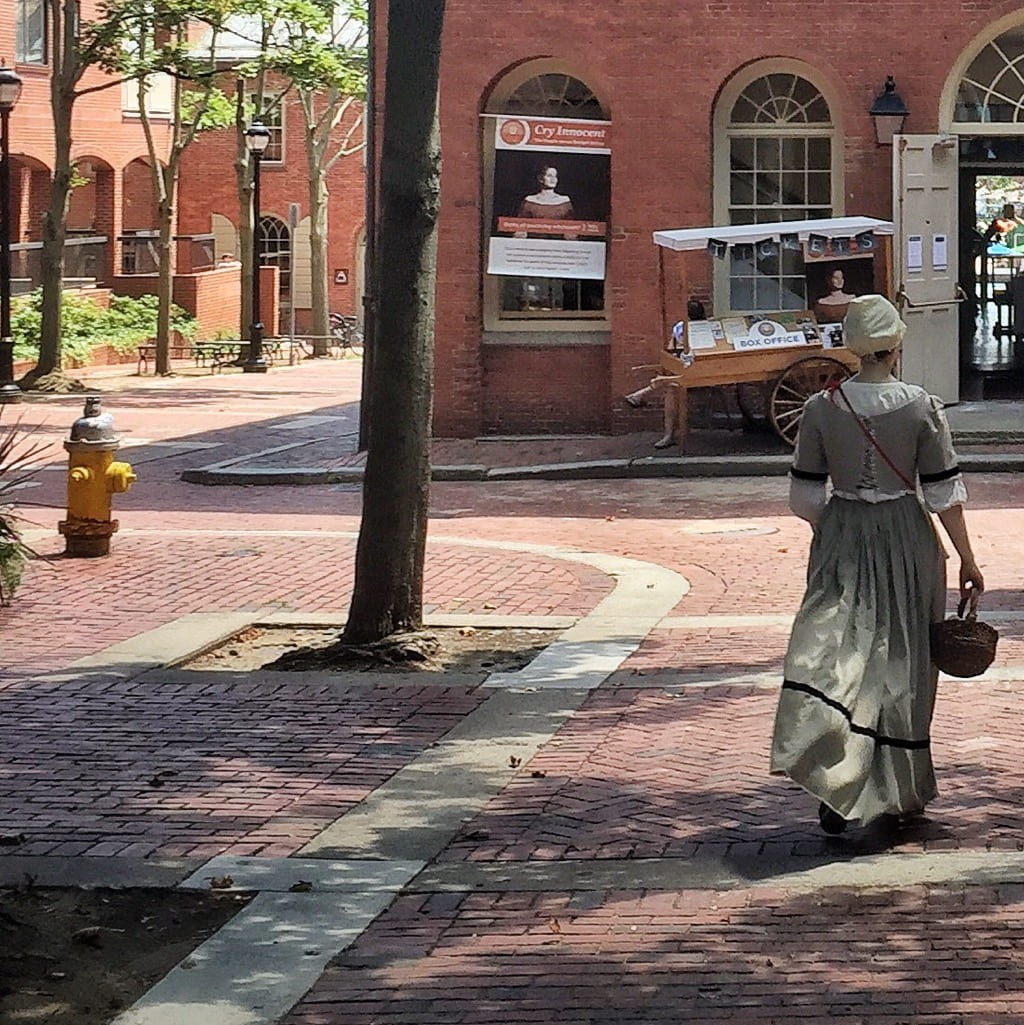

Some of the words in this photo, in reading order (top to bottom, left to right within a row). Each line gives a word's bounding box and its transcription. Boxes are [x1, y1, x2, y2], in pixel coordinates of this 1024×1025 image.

[534, 124, 556, 139] Cry
[556, 125, 606, 138] Innocent
[711, 233, 874, 259] TICKETS
[740, 339, 762, 348] BOX
[763, 335, 801, 345] OFFICE
